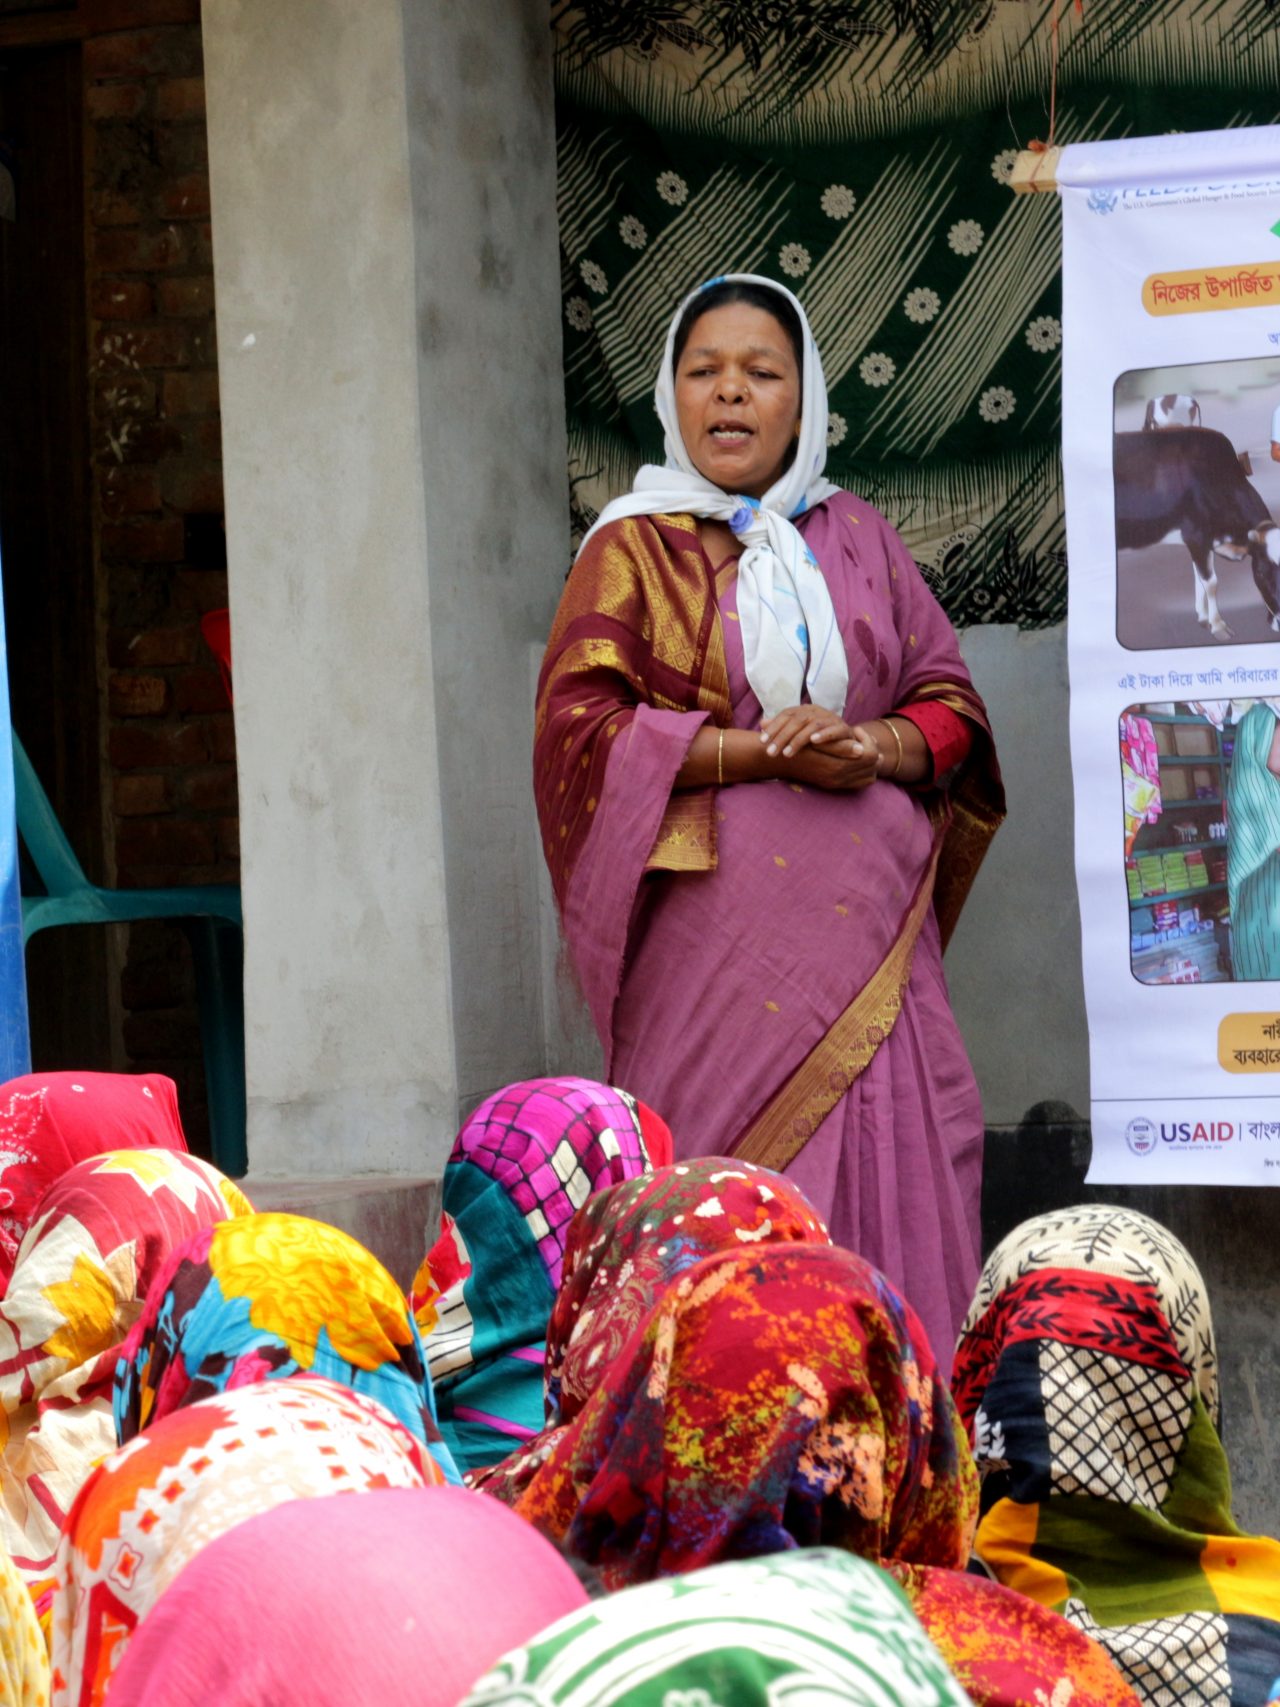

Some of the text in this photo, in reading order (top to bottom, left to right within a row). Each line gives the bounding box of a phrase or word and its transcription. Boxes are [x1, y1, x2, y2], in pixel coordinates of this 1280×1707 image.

[1151, 279, 1202, 305] নিজের
[1205, 268, 1274, 298] উপার্জিত
[1118, 673, 1137, 690] এই
[1139, 672, 1165, 689] টাকা
[1197, 667, 1223, 686] আমি
[1227, 665, 1279, 684] পরিবারের
[1160, 1122, 1234, 1143] USAID
